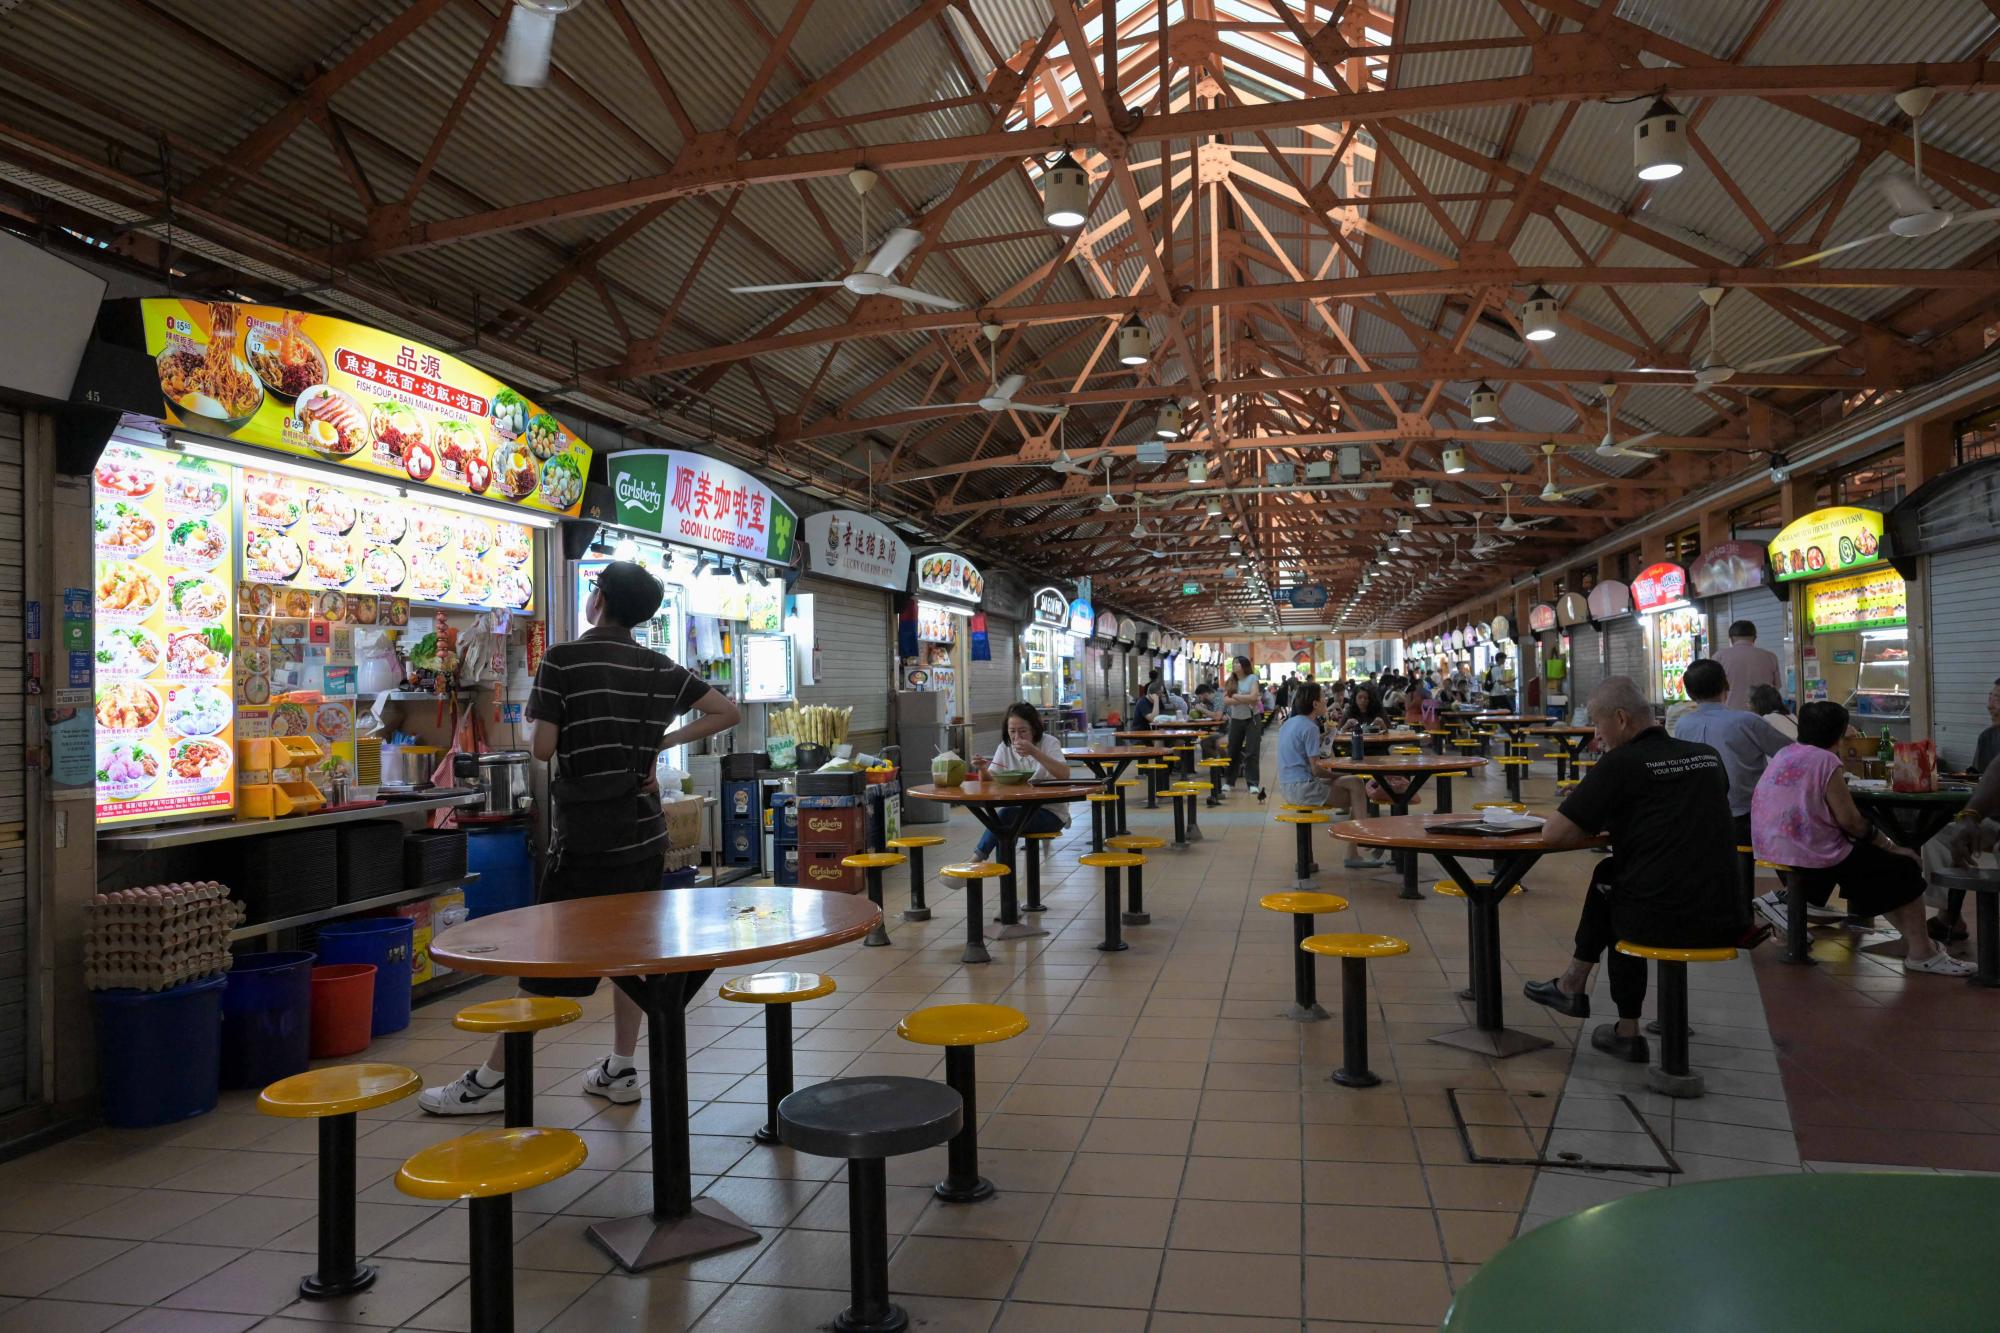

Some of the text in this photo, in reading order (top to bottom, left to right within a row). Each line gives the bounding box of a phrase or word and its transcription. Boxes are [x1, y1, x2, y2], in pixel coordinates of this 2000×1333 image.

[397, 345, 442, 380] 品源
[86, 390, 100, 402] 45
[356, 380, 468, 424] FISH SOUP BAN MIAN PAO FAN
[616, 471, 661, 511] Carlsberg
[671, 466, 764, 534] 顺美咖啡室
[680, 518, 702, 540] SOON
[704, 525, 710, 538] LI
[713, 527, 735, 547] COFFEE
[737, 534, 754, 551] SHOP
[1644, 760, 1667, 768] THANK
[1653, 767, 1669, 775] YOUR
[808, 817, 842, 833] Carlsberg
[808, 865, 842, 881] Carlsberg
